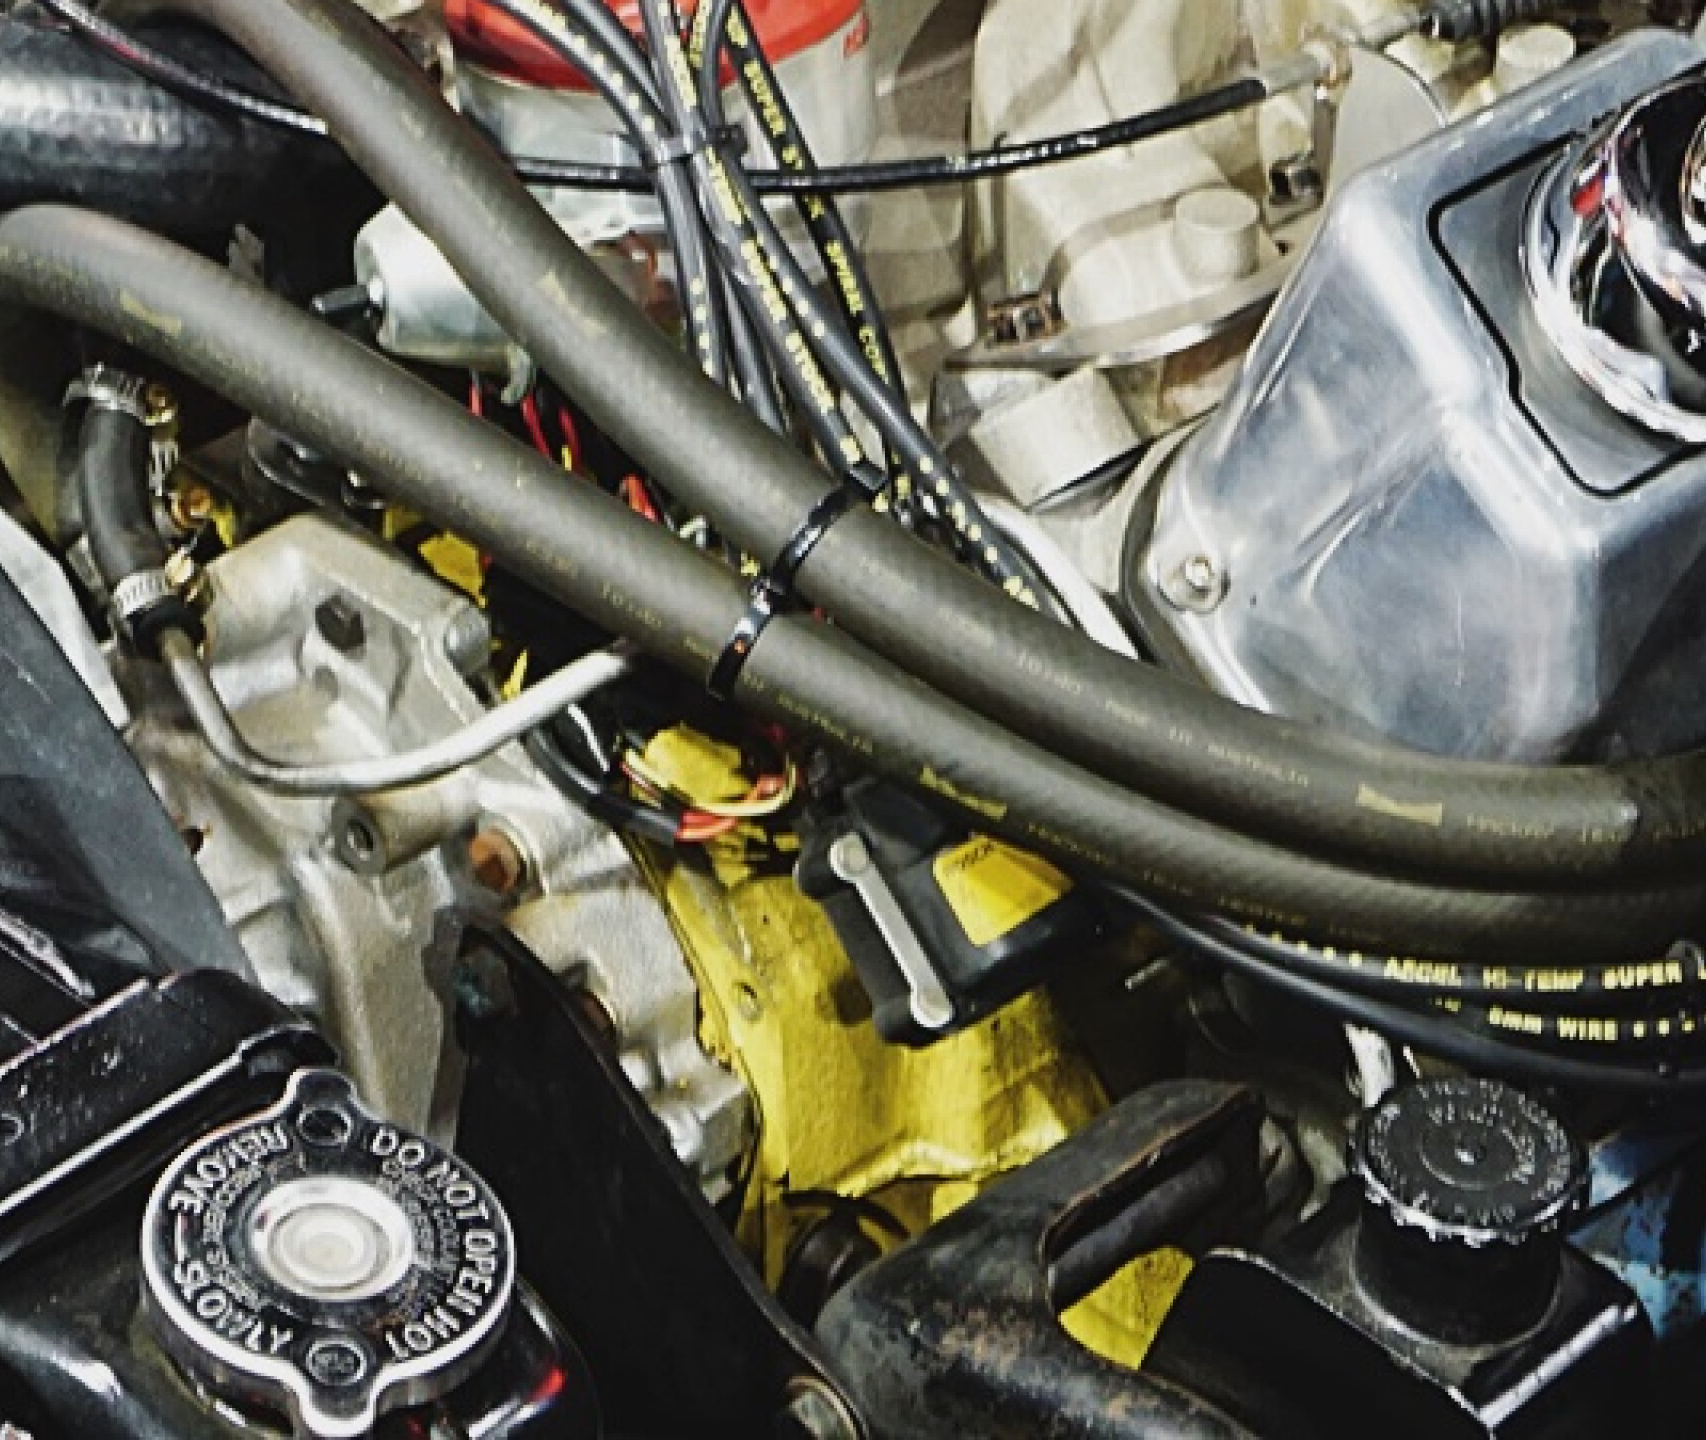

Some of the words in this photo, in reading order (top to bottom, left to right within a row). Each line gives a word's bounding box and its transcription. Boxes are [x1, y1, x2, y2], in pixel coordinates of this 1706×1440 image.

[1601, 961, 1684, 990] SUPER
[1556, 1016, 1619, 1041] WIRE
[372, 1127, 426, 1167] DO
[427, 1159, 491, 1222] NOT
